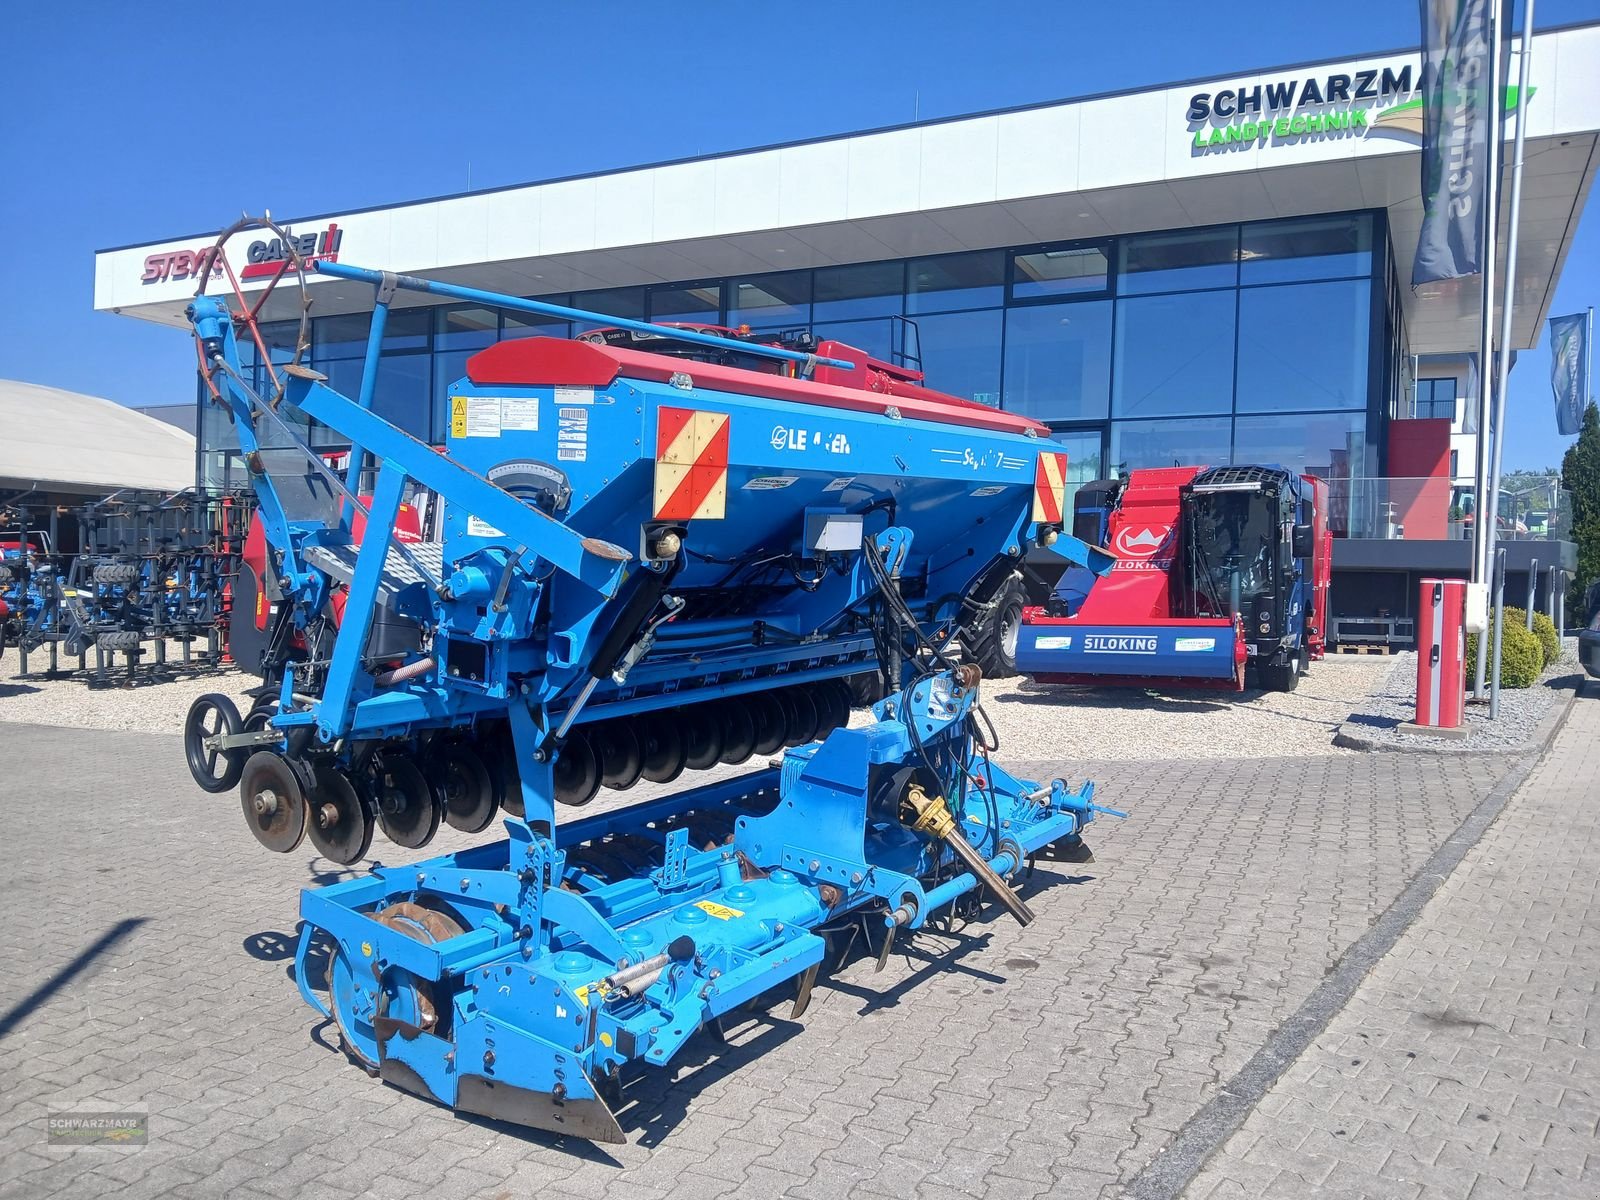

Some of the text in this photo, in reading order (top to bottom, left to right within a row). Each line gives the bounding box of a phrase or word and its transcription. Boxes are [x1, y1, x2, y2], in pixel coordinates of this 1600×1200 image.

[1195, 108, 1368, 147] LANDTECHNIK
[1112, 561, 1170, 569] ILOKING
[1084, 638, 1158, 651] SILOKING
